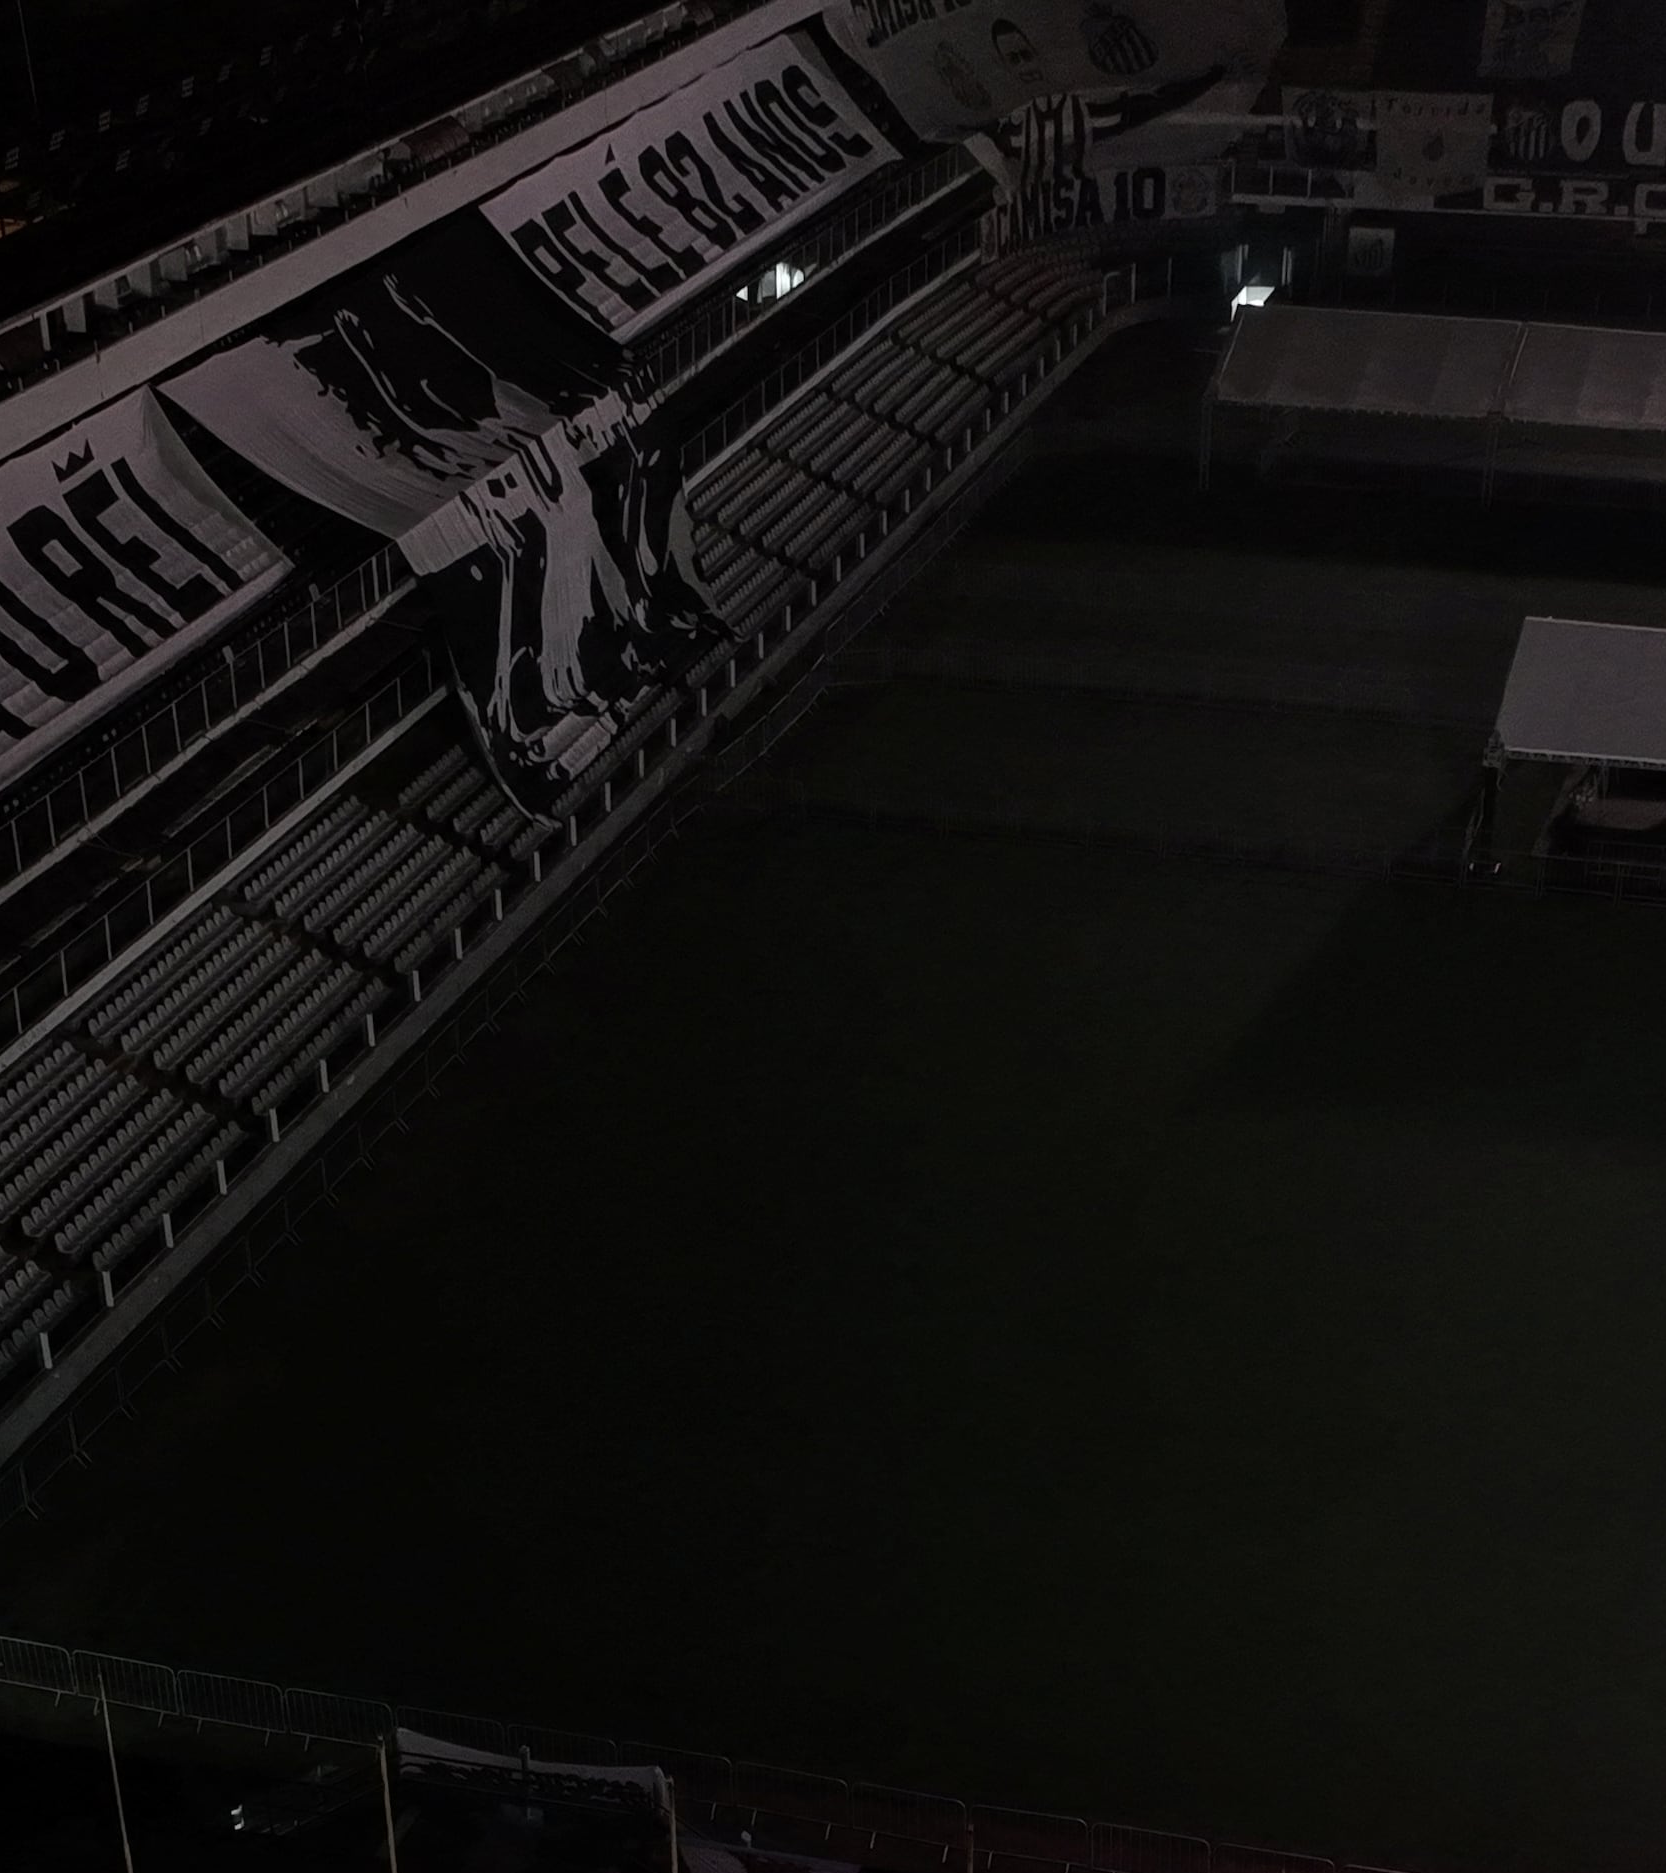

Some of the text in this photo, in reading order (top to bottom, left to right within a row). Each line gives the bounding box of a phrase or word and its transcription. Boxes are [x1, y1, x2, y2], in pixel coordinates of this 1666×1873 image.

[1560, 98, 1602, 162] O
[510, 64, 874, 334] PELÉ 82 ANOS
[1114, 167, 1166, 220] 10
